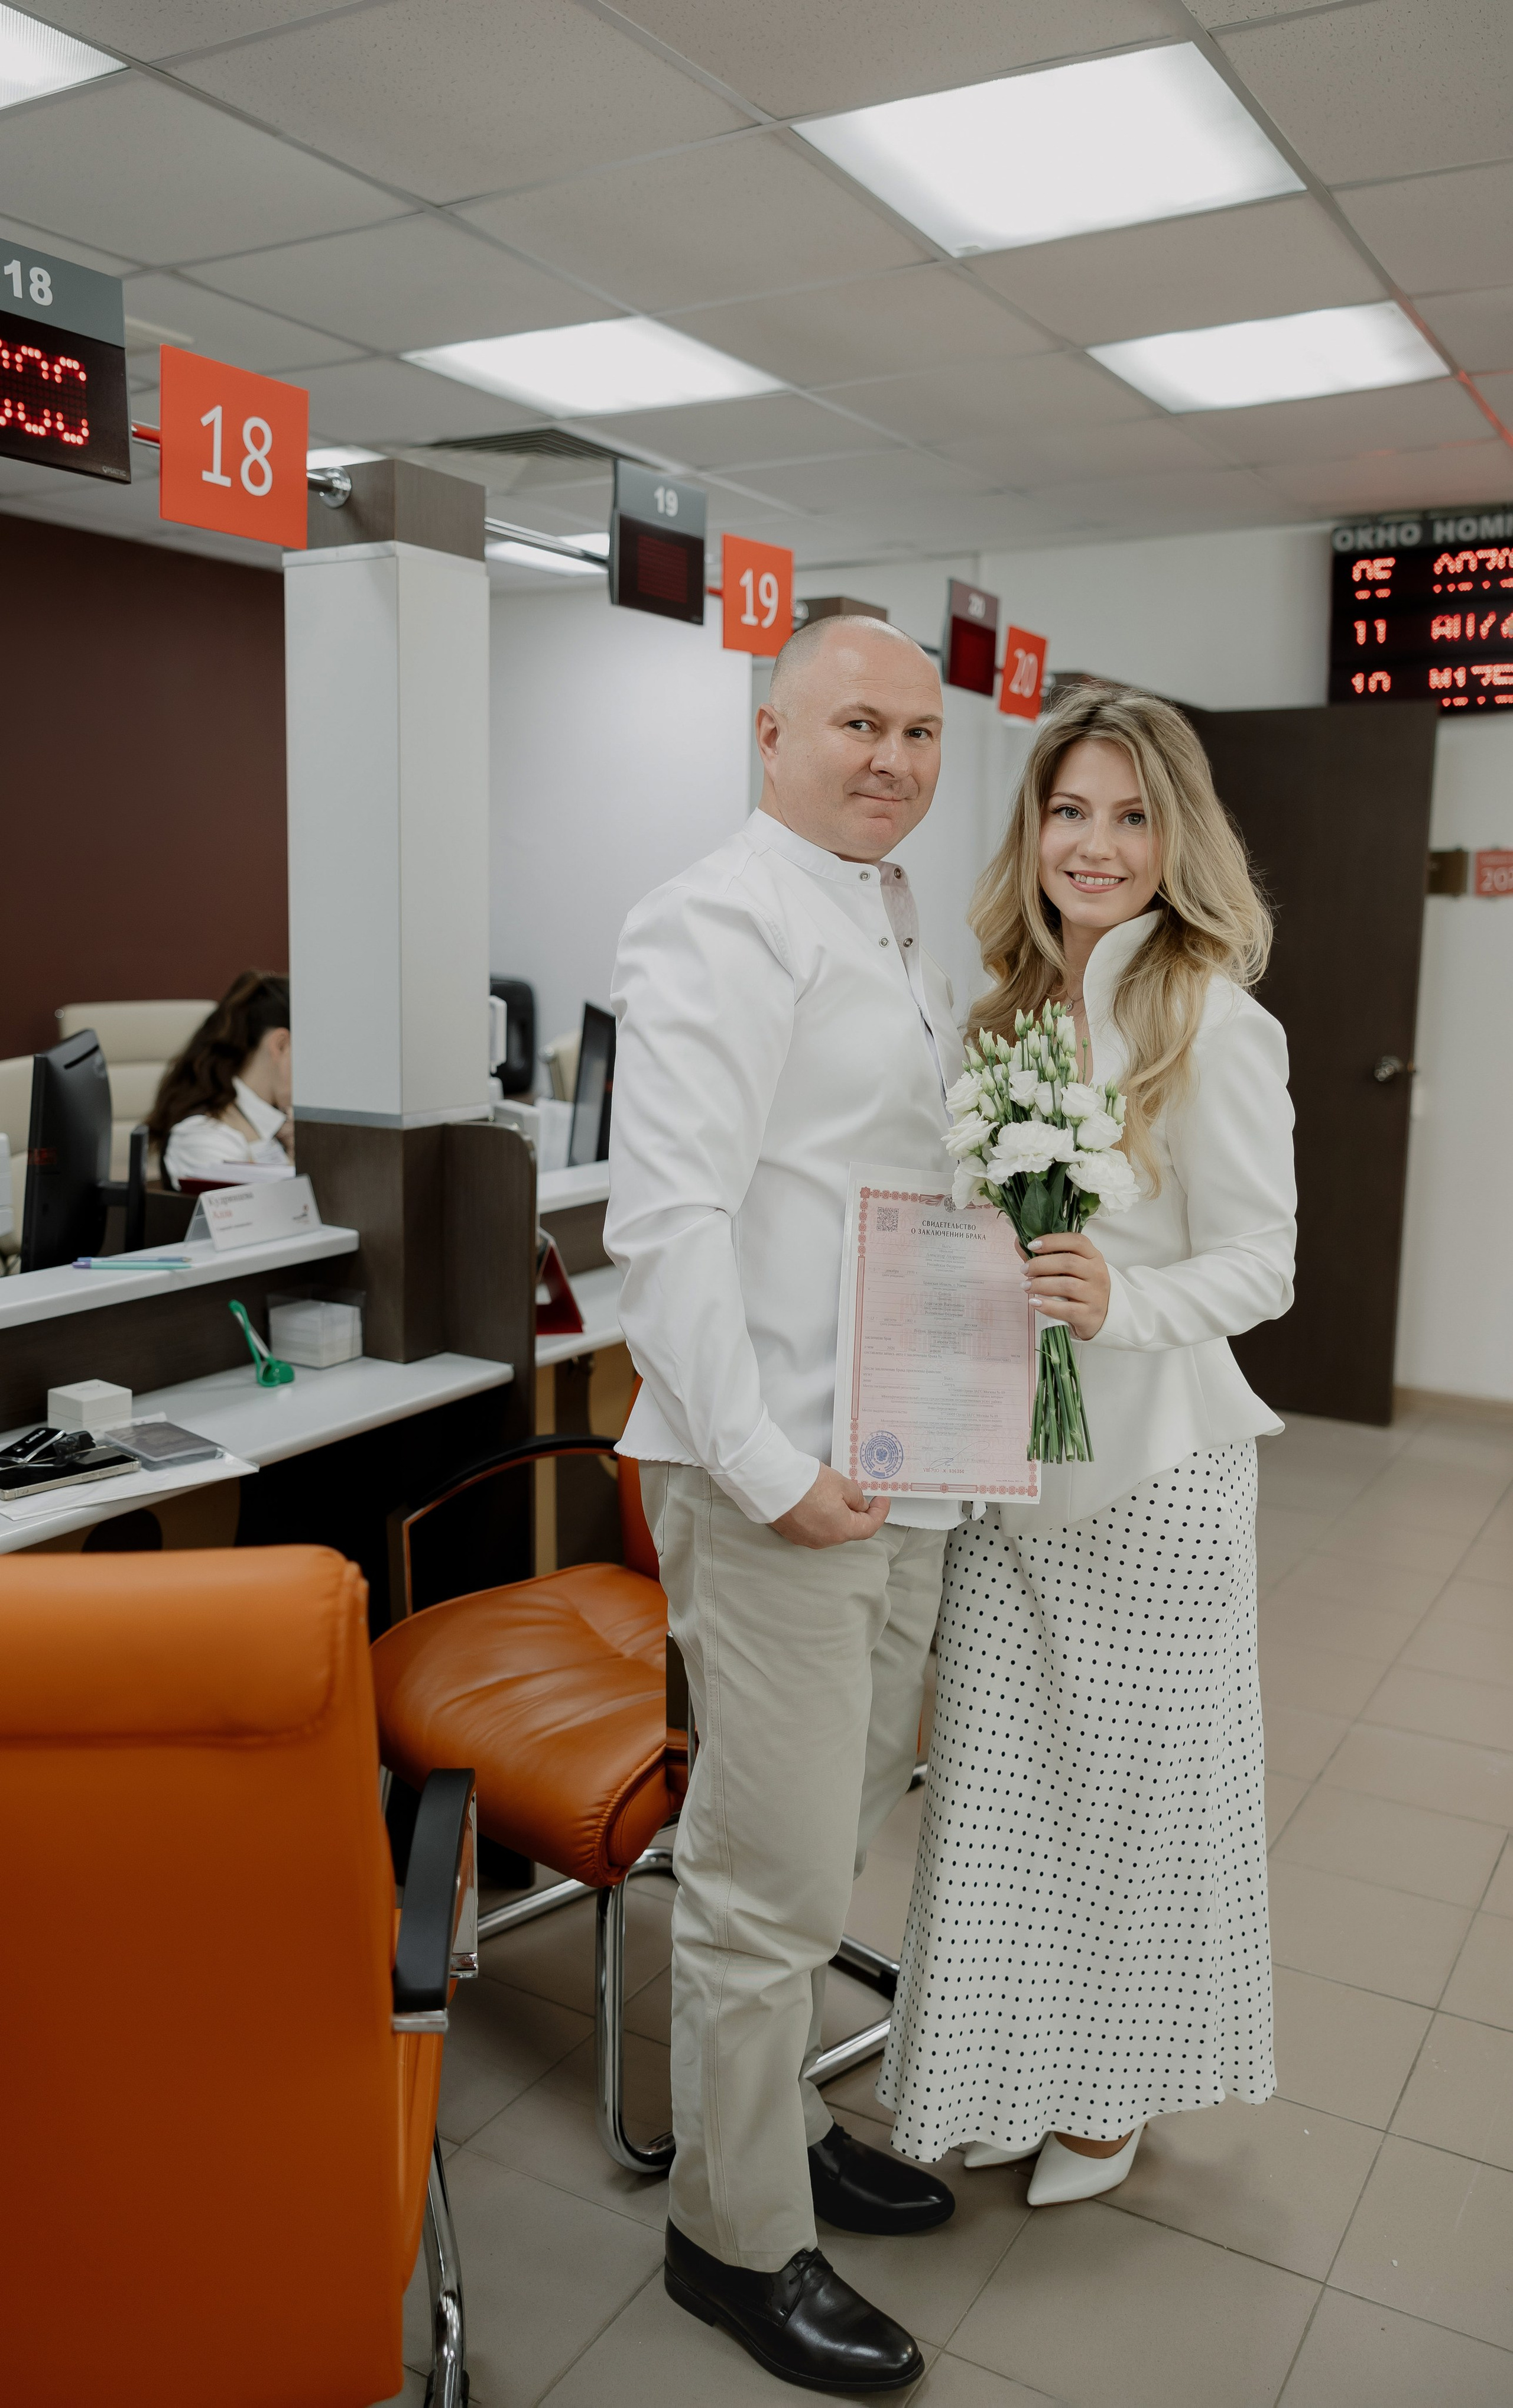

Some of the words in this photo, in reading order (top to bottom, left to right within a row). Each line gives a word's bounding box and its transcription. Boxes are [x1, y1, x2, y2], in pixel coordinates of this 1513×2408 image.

[3, 259, 53, 306] 18
[200, 404, 274, 496] 18
[654, 485, 678, 517] 19
[1333, 523, 1421, 552] ОКНО
[739, 568, 779, 629] 19
[1008, 648, 1038, 698] 20
[918, 1228, 964, 1238] ЗАКЛЮЧЕНИИ
[922, 1220, 976, 1231] СВИДЕТЕЛЬСТВО
